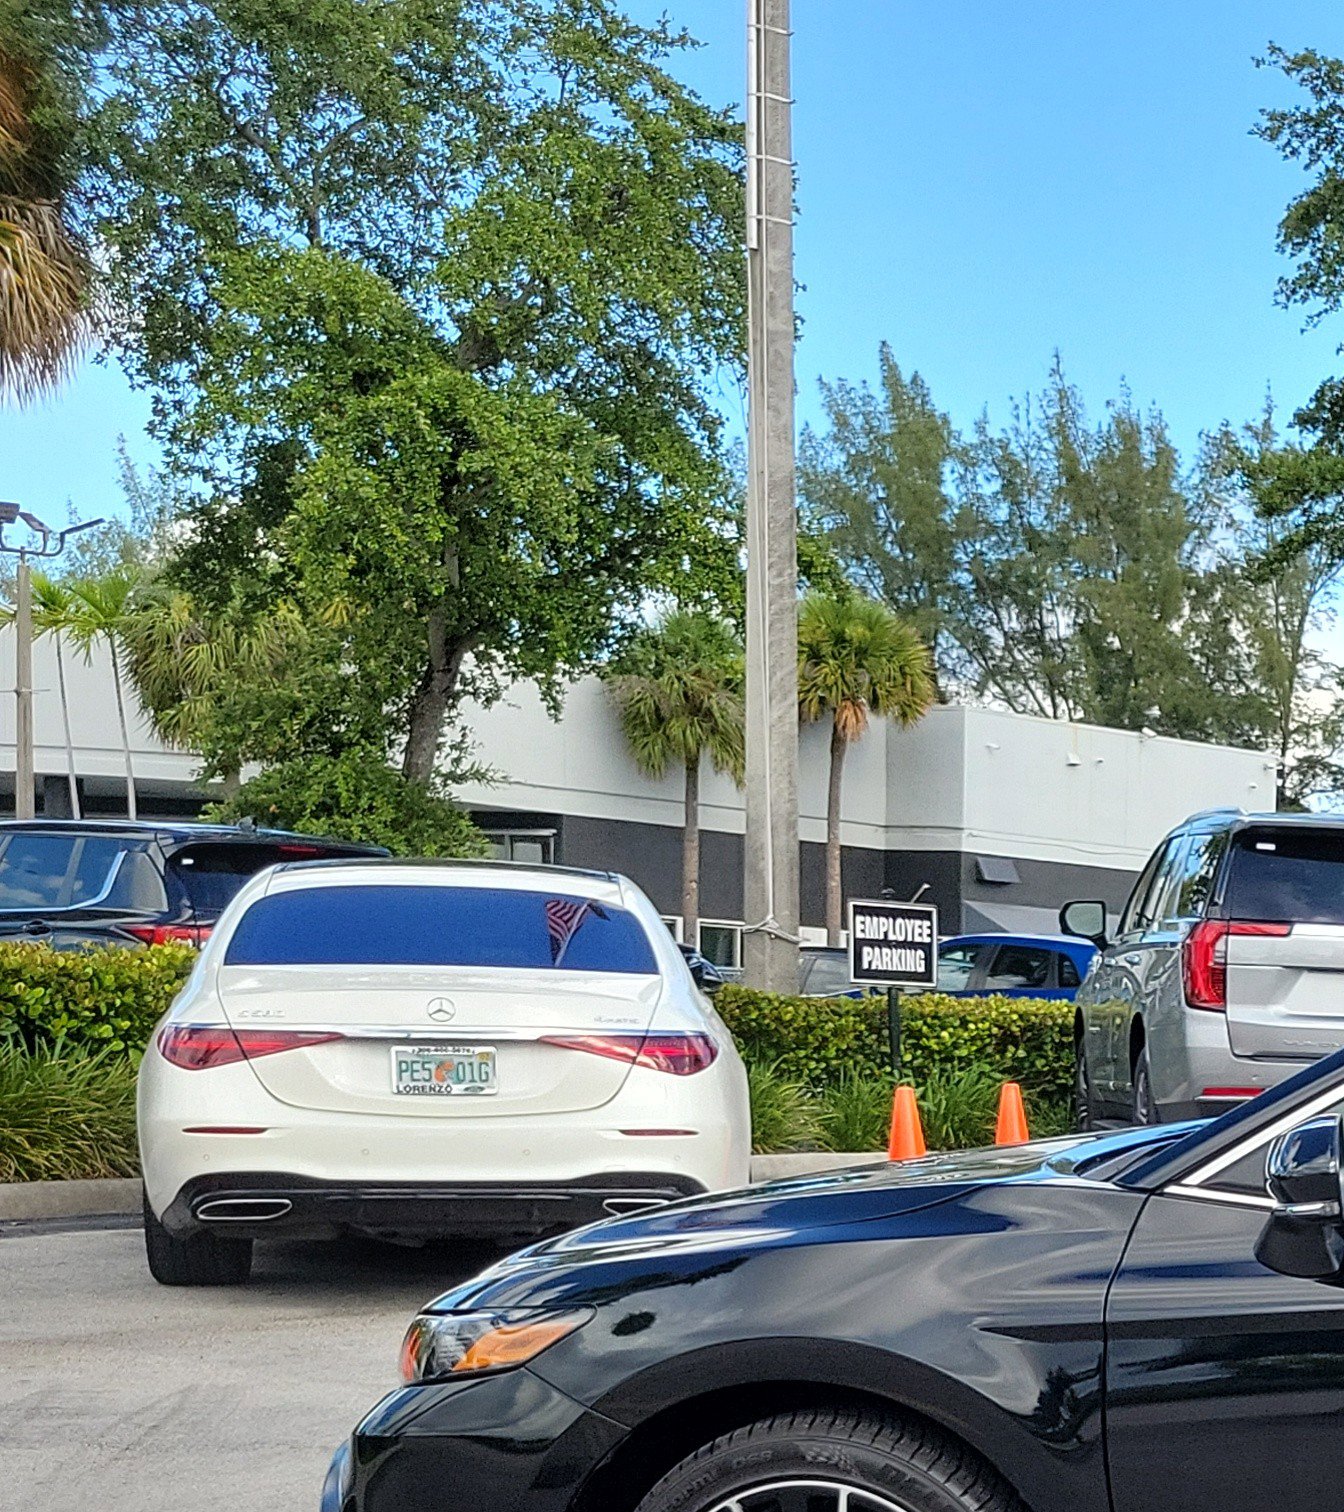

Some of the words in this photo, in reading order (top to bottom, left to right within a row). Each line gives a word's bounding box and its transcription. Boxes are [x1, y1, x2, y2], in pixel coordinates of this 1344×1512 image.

[855, 914, 932, 943] EMPLOYEE
[862, 946, 925, 973] PARKING
[397, 1084, 453, 1094] LORENZO
